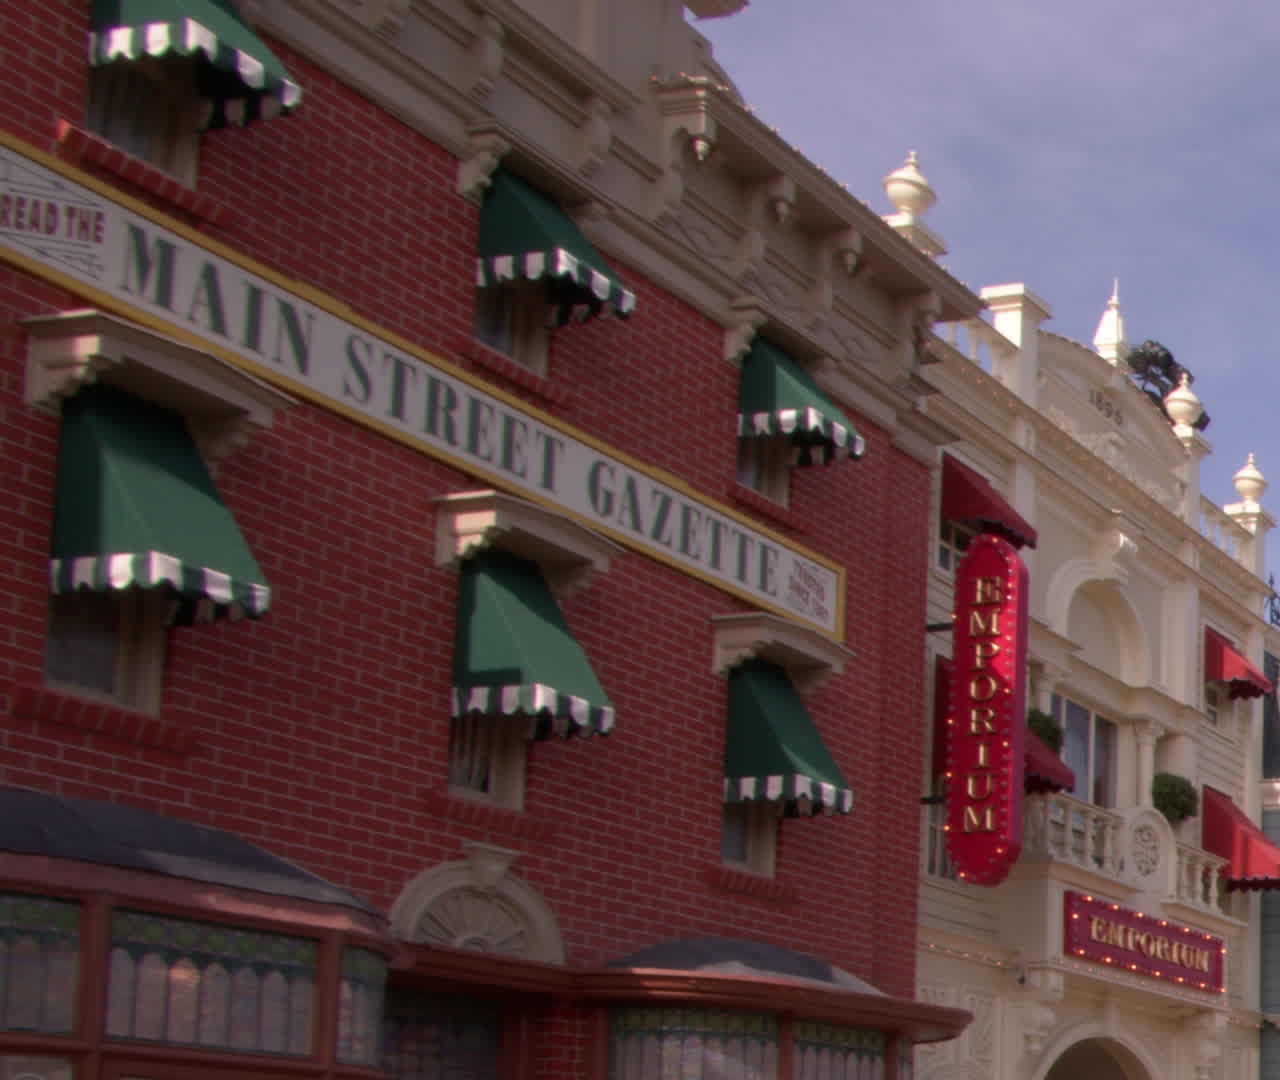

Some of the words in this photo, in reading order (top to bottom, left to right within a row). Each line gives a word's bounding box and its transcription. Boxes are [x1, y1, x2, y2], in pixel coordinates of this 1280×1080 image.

[0, 192, 59, 235] READ
[64, 205, 105, 244] THE
[120, 216, 317, 377] MAIN
[342, 333, 565, 494] STREET
[587, 459, 781, 598] GAZETTE
[963, 575, 1003, 833] EMPORIUM
[1089, 915, 1210, 972] EMPORIUM
